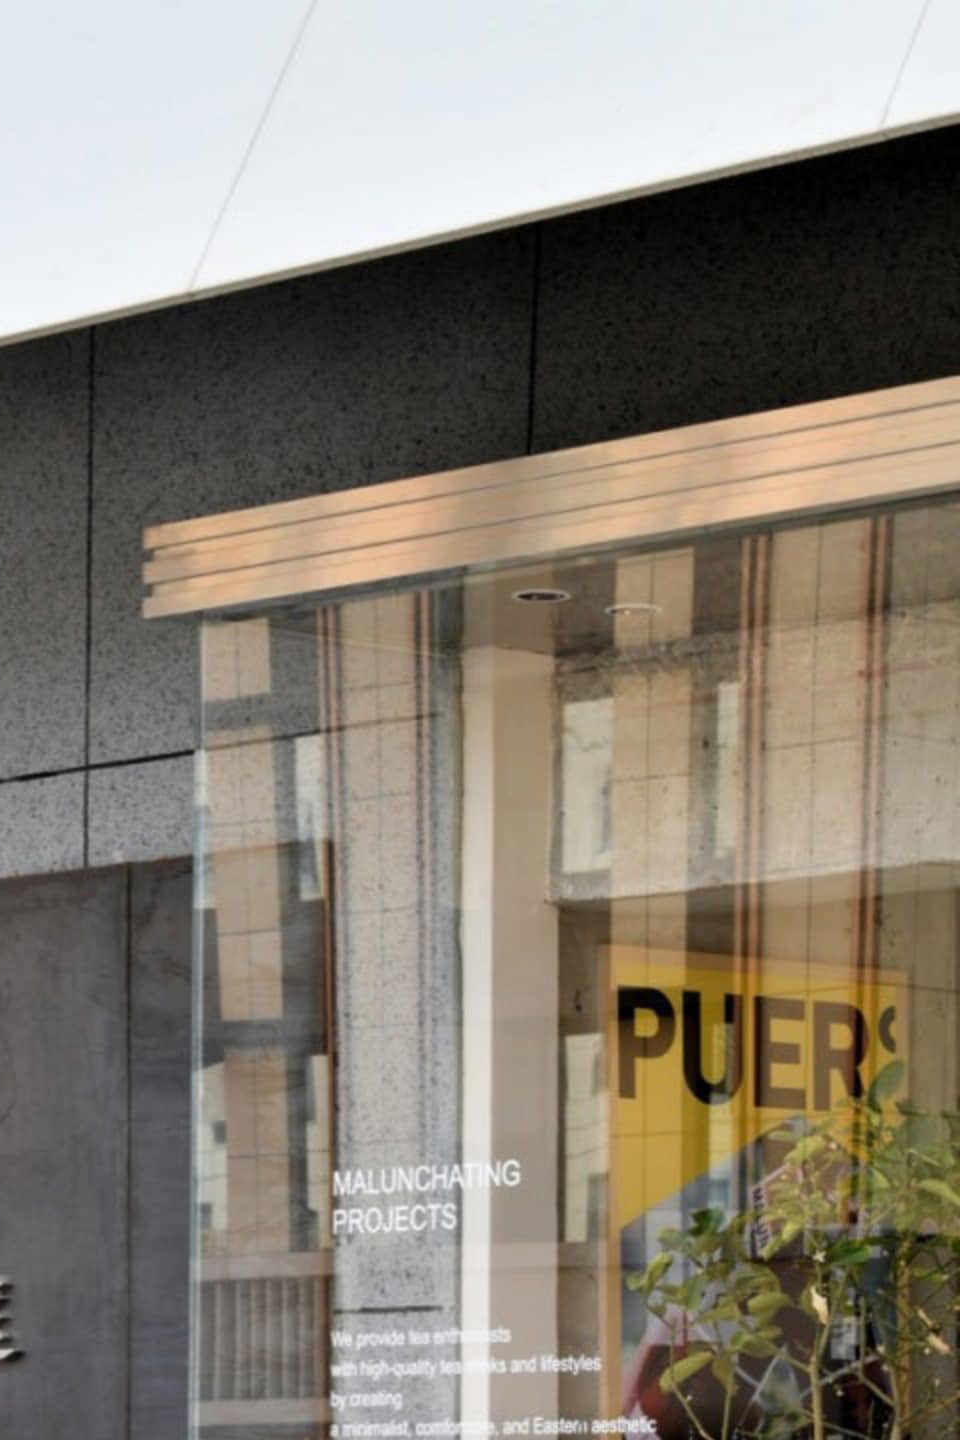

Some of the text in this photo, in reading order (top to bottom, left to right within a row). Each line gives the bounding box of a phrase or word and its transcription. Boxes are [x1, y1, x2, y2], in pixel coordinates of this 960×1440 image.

[332, 1159, 521, 1196] MALUNCHATING
[332, 1203, 458, 1235] PROJECTS
[330, 1330, 353, 1347] We
[356, 1330, 406, 1350] provide
[359, 1359, 436, 1380] high-quality
[510, 1356, 537, 1373] and
[541, 1354, 602, 1376] lifestyles
[330, 1390, 403, 1412] by creating
[329, 1423, 339, 1438] a
[502, 1418, 529, 1435] and
[533, 1416, 588, 1435] Eastern
[591, 1415, 657, 1434] aesthetic
